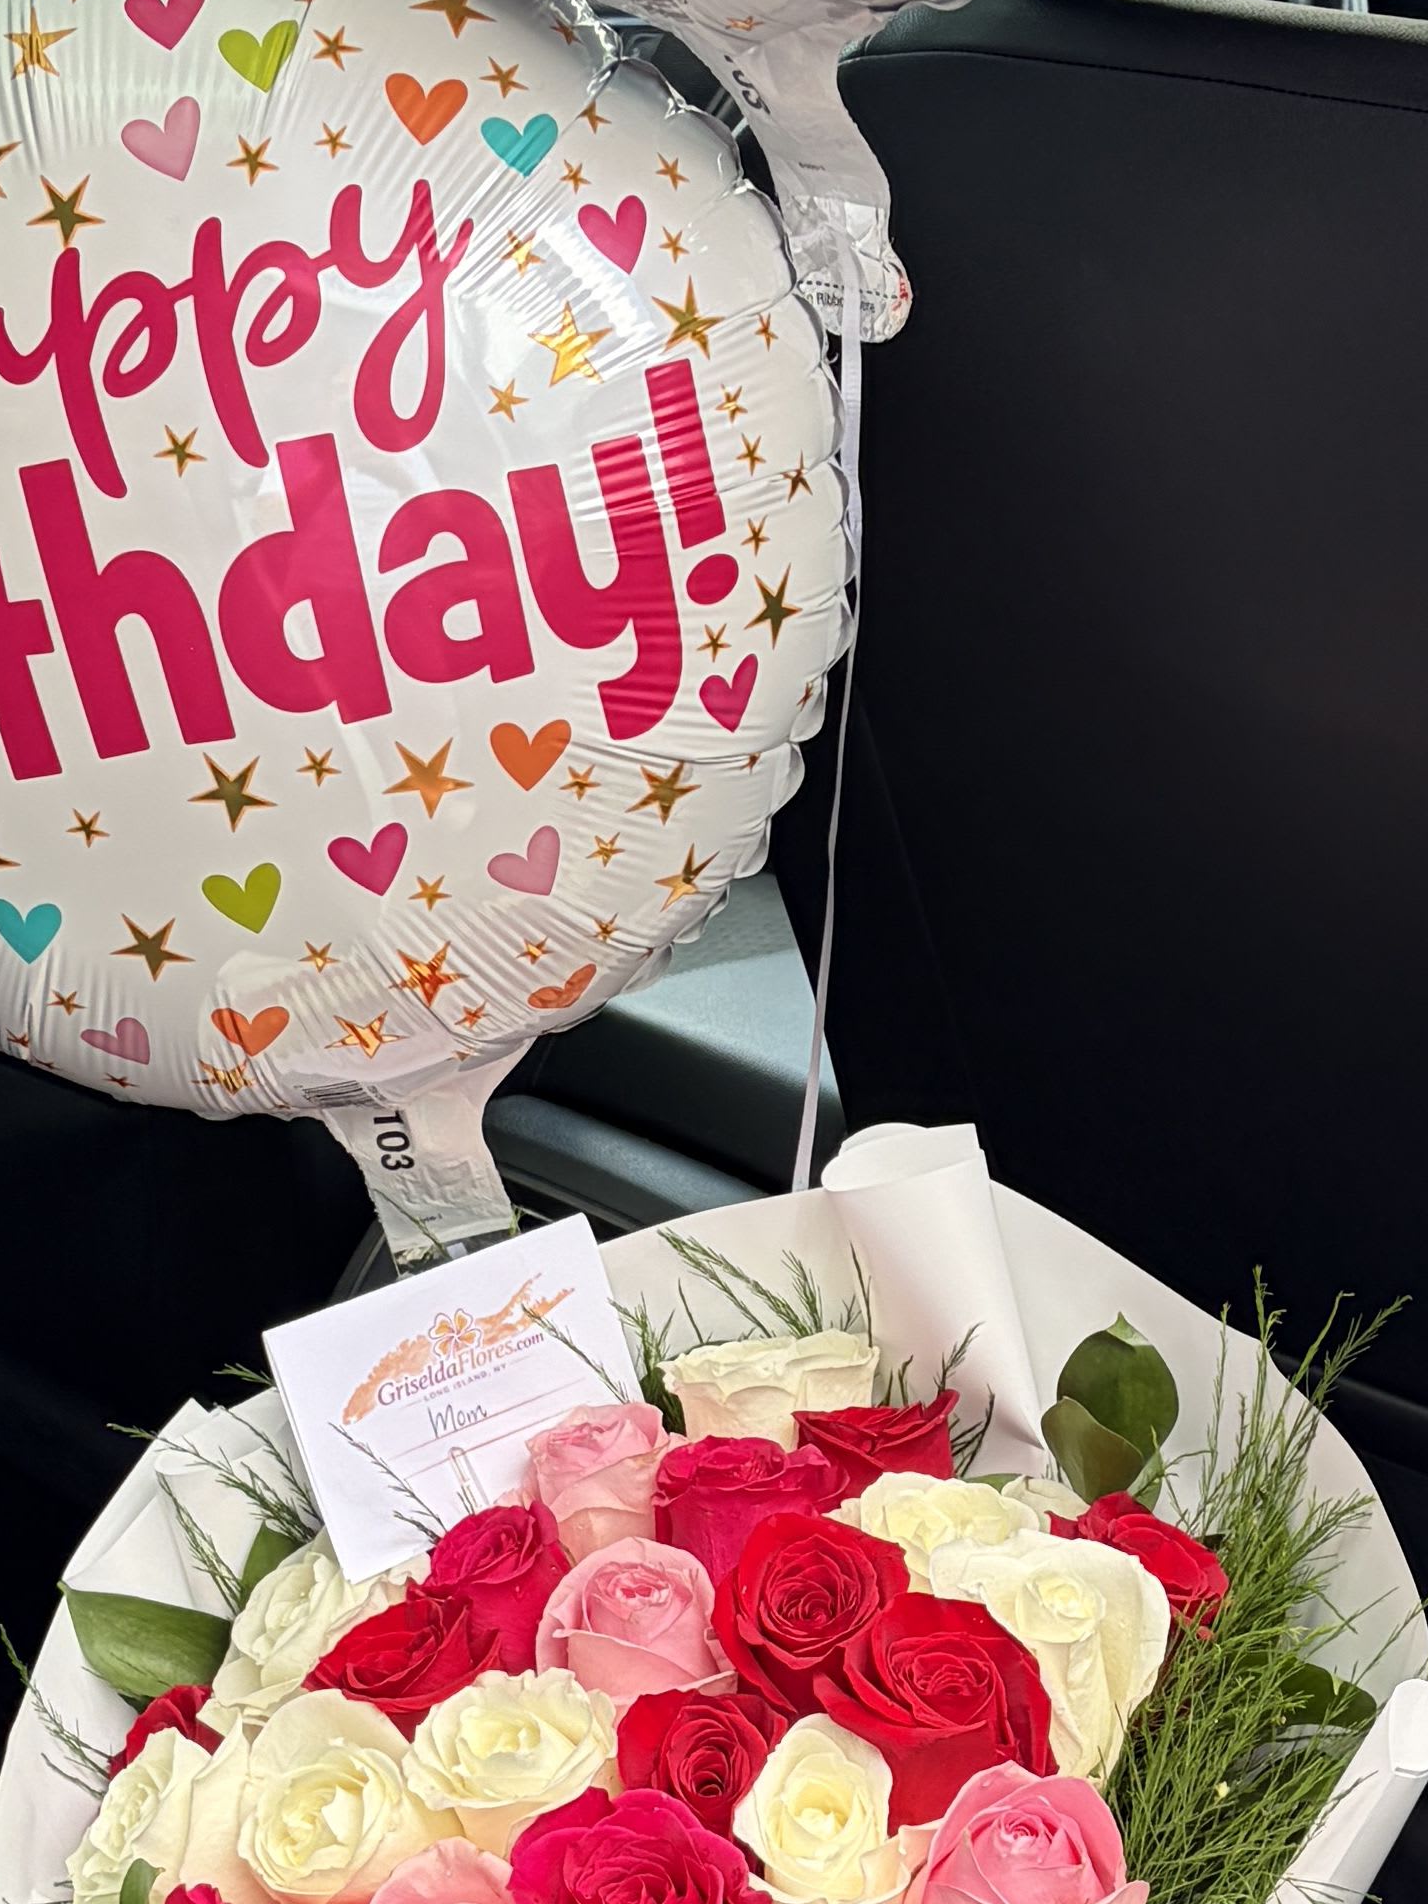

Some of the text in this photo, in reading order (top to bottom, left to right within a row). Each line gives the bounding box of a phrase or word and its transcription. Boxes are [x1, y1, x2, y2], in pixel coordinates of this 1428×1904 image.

[377, 1332, 545, 1406] GriseldaFlores.com
[424, 1386, 450, 1402] LONG
[493, 1363, 507, 1373] NY
[427, 1403, 488, 1439] Mom
